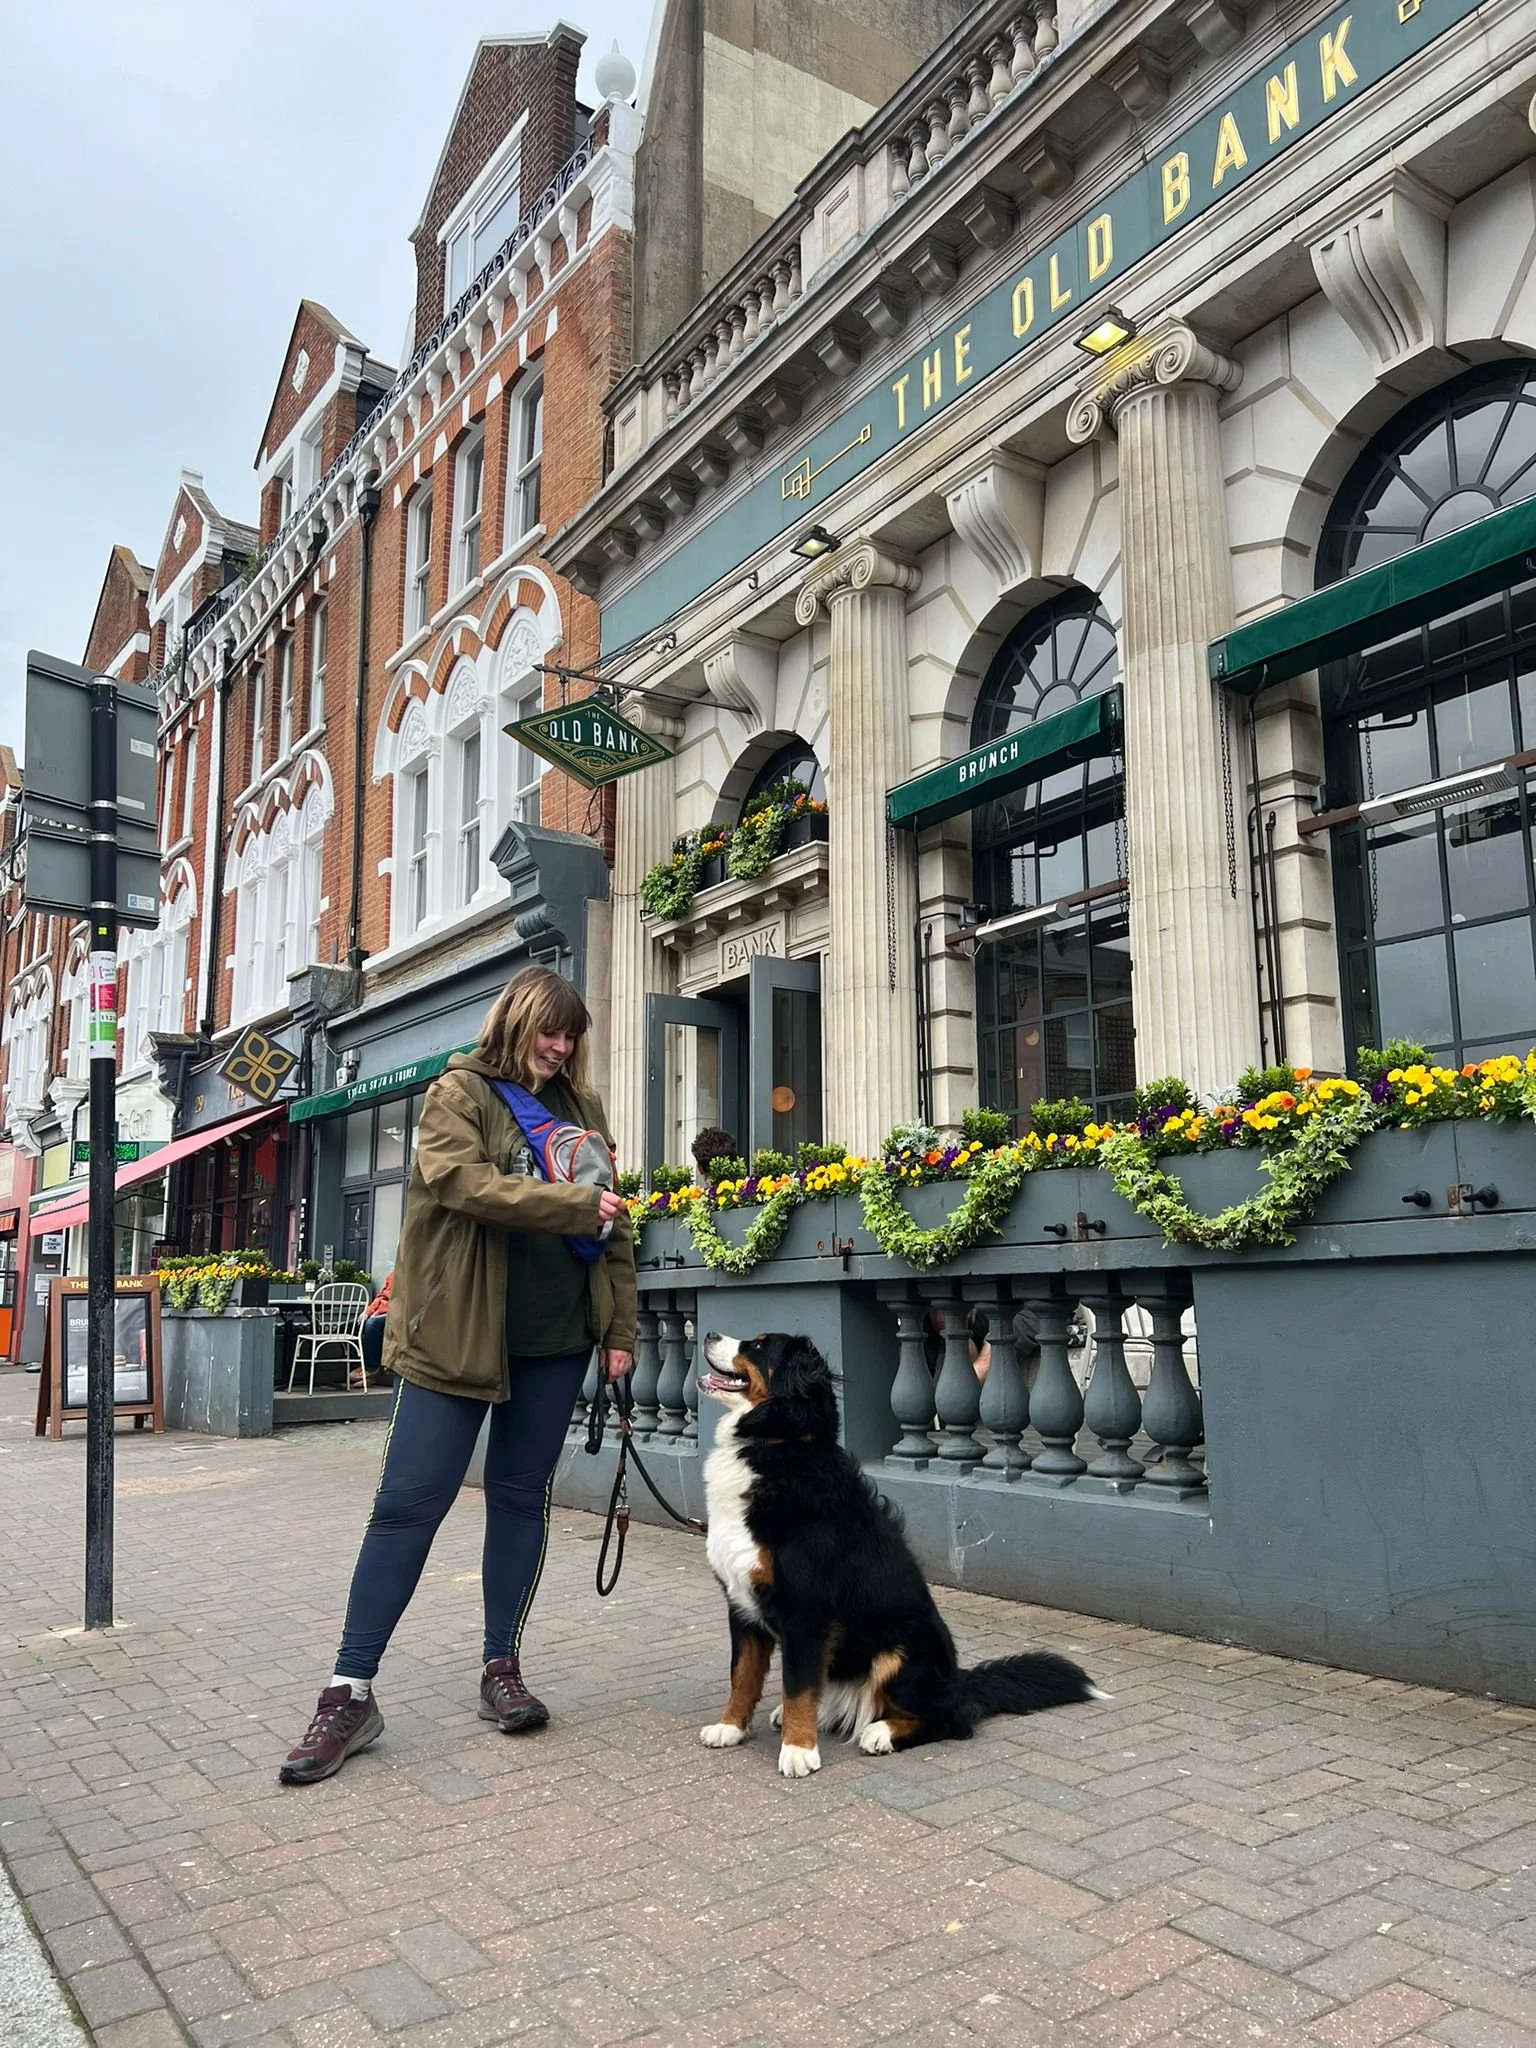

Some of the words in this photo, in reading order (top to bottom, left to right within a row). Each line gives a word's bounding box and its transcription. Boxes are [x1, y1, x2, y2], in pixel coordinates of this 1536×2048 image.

[891, 322, 974, 431] THE
[1010, 213, 1115, 340] OLD
[1161, 14, 1360, 226] BANK
[587, 711, 600, 720] THE
[549, 720, 582, 743] OLD
[592, 722, 640, 755] BANK
[959, 741, 1019, 783] BRUNCH
[727, 927, 777, 970] BANK
[70, 1281, 88, 1289] THE
[116, 1280, 143, 1288] BANK
